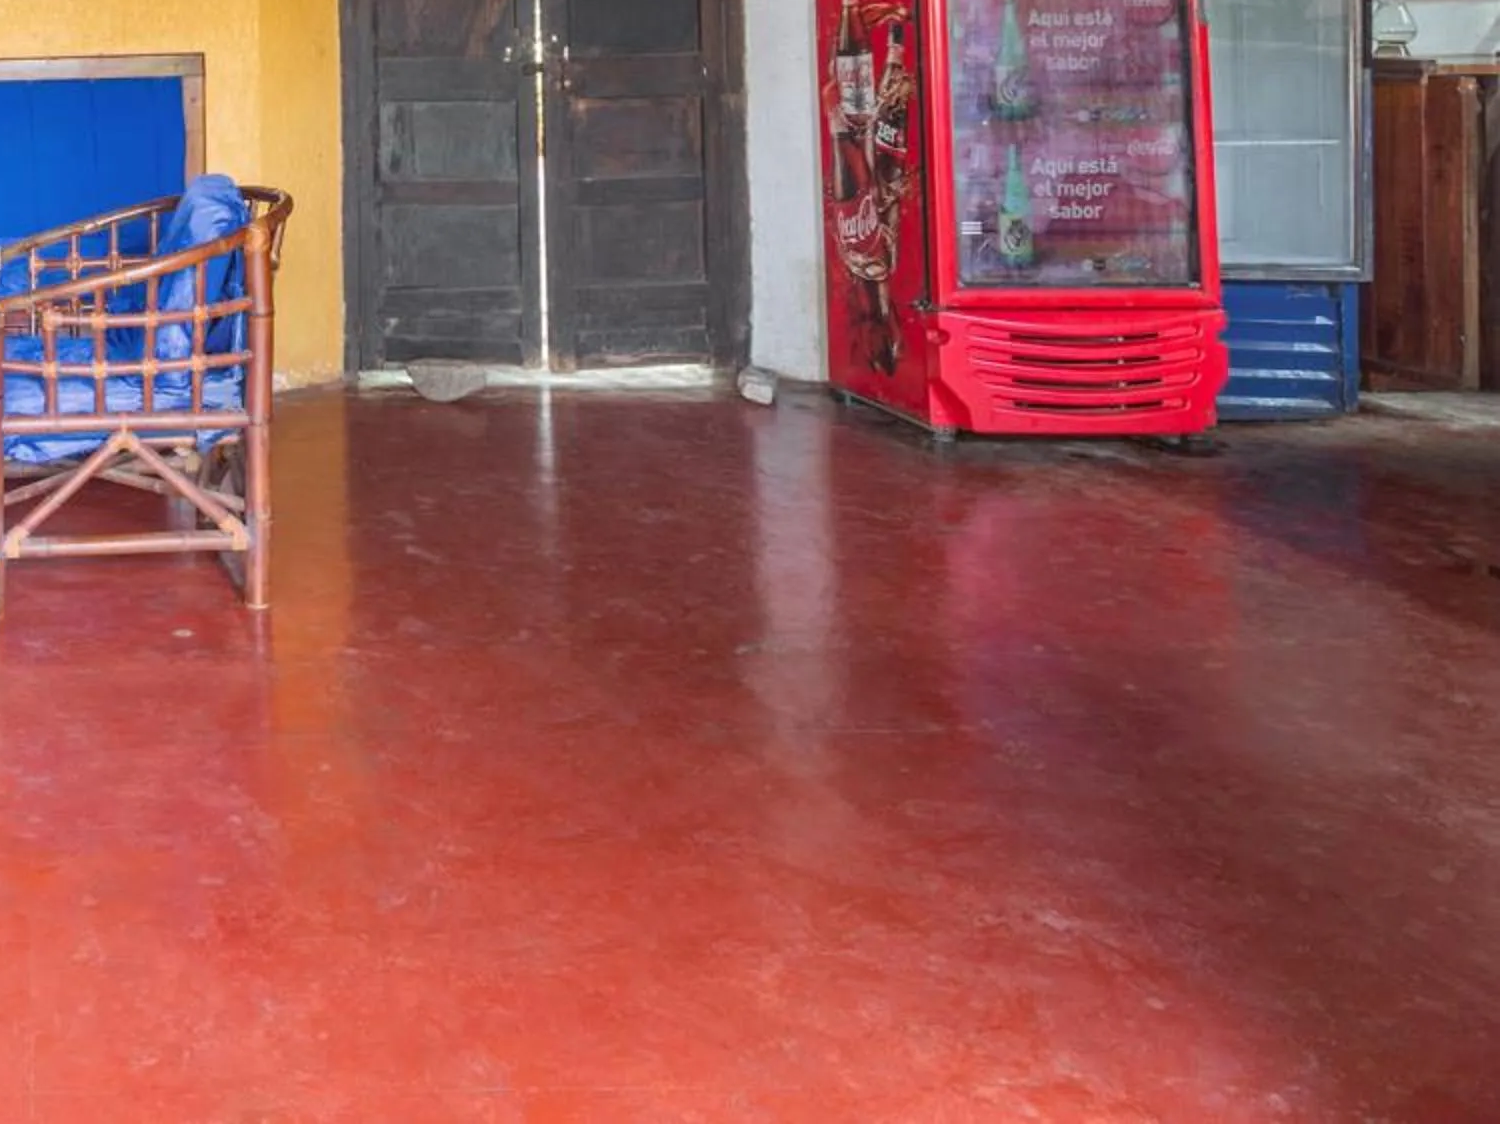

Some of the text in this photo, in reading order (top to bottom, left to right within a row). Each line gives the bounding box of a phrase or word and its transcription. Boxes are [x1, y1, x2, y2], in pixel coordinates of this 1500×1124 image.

[1053, 33, 1107, 51] mejor
[1078, 156, 1119, 175] está
[1033, 180, 1113, 200] el mejor
[1050, 203, 1105, 219] sabor
